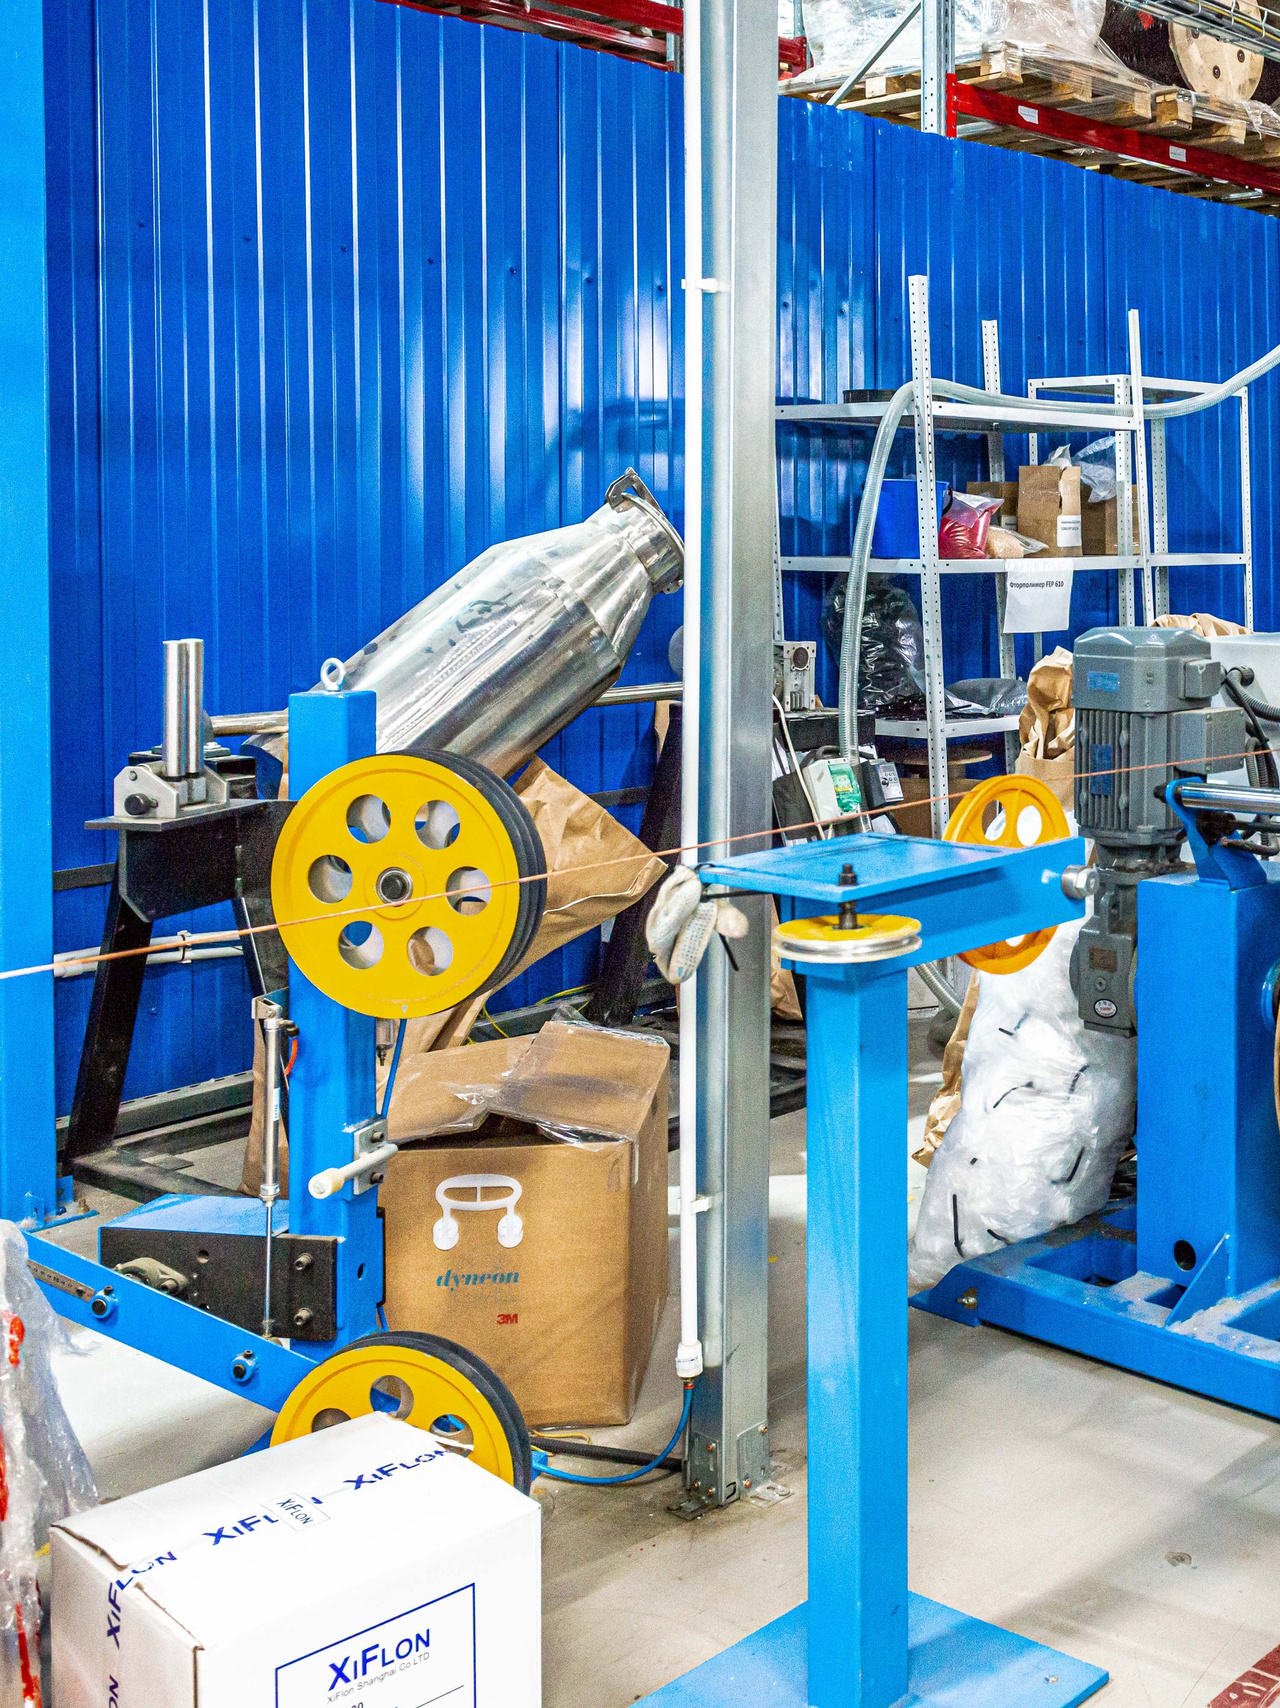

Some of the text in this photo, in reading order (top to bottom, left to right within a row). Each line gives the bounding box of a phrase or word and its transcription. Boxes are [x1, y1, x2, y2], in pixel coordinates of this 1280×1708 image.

[1046, 580, 1054, 588] FEP
[496, 1313, 519, 1325] 3M
[357, 1669, 397, 1691] Shanghai
[399, 1661, 412, 1671] Co
[413, 1651, 430, 1665] LTD
